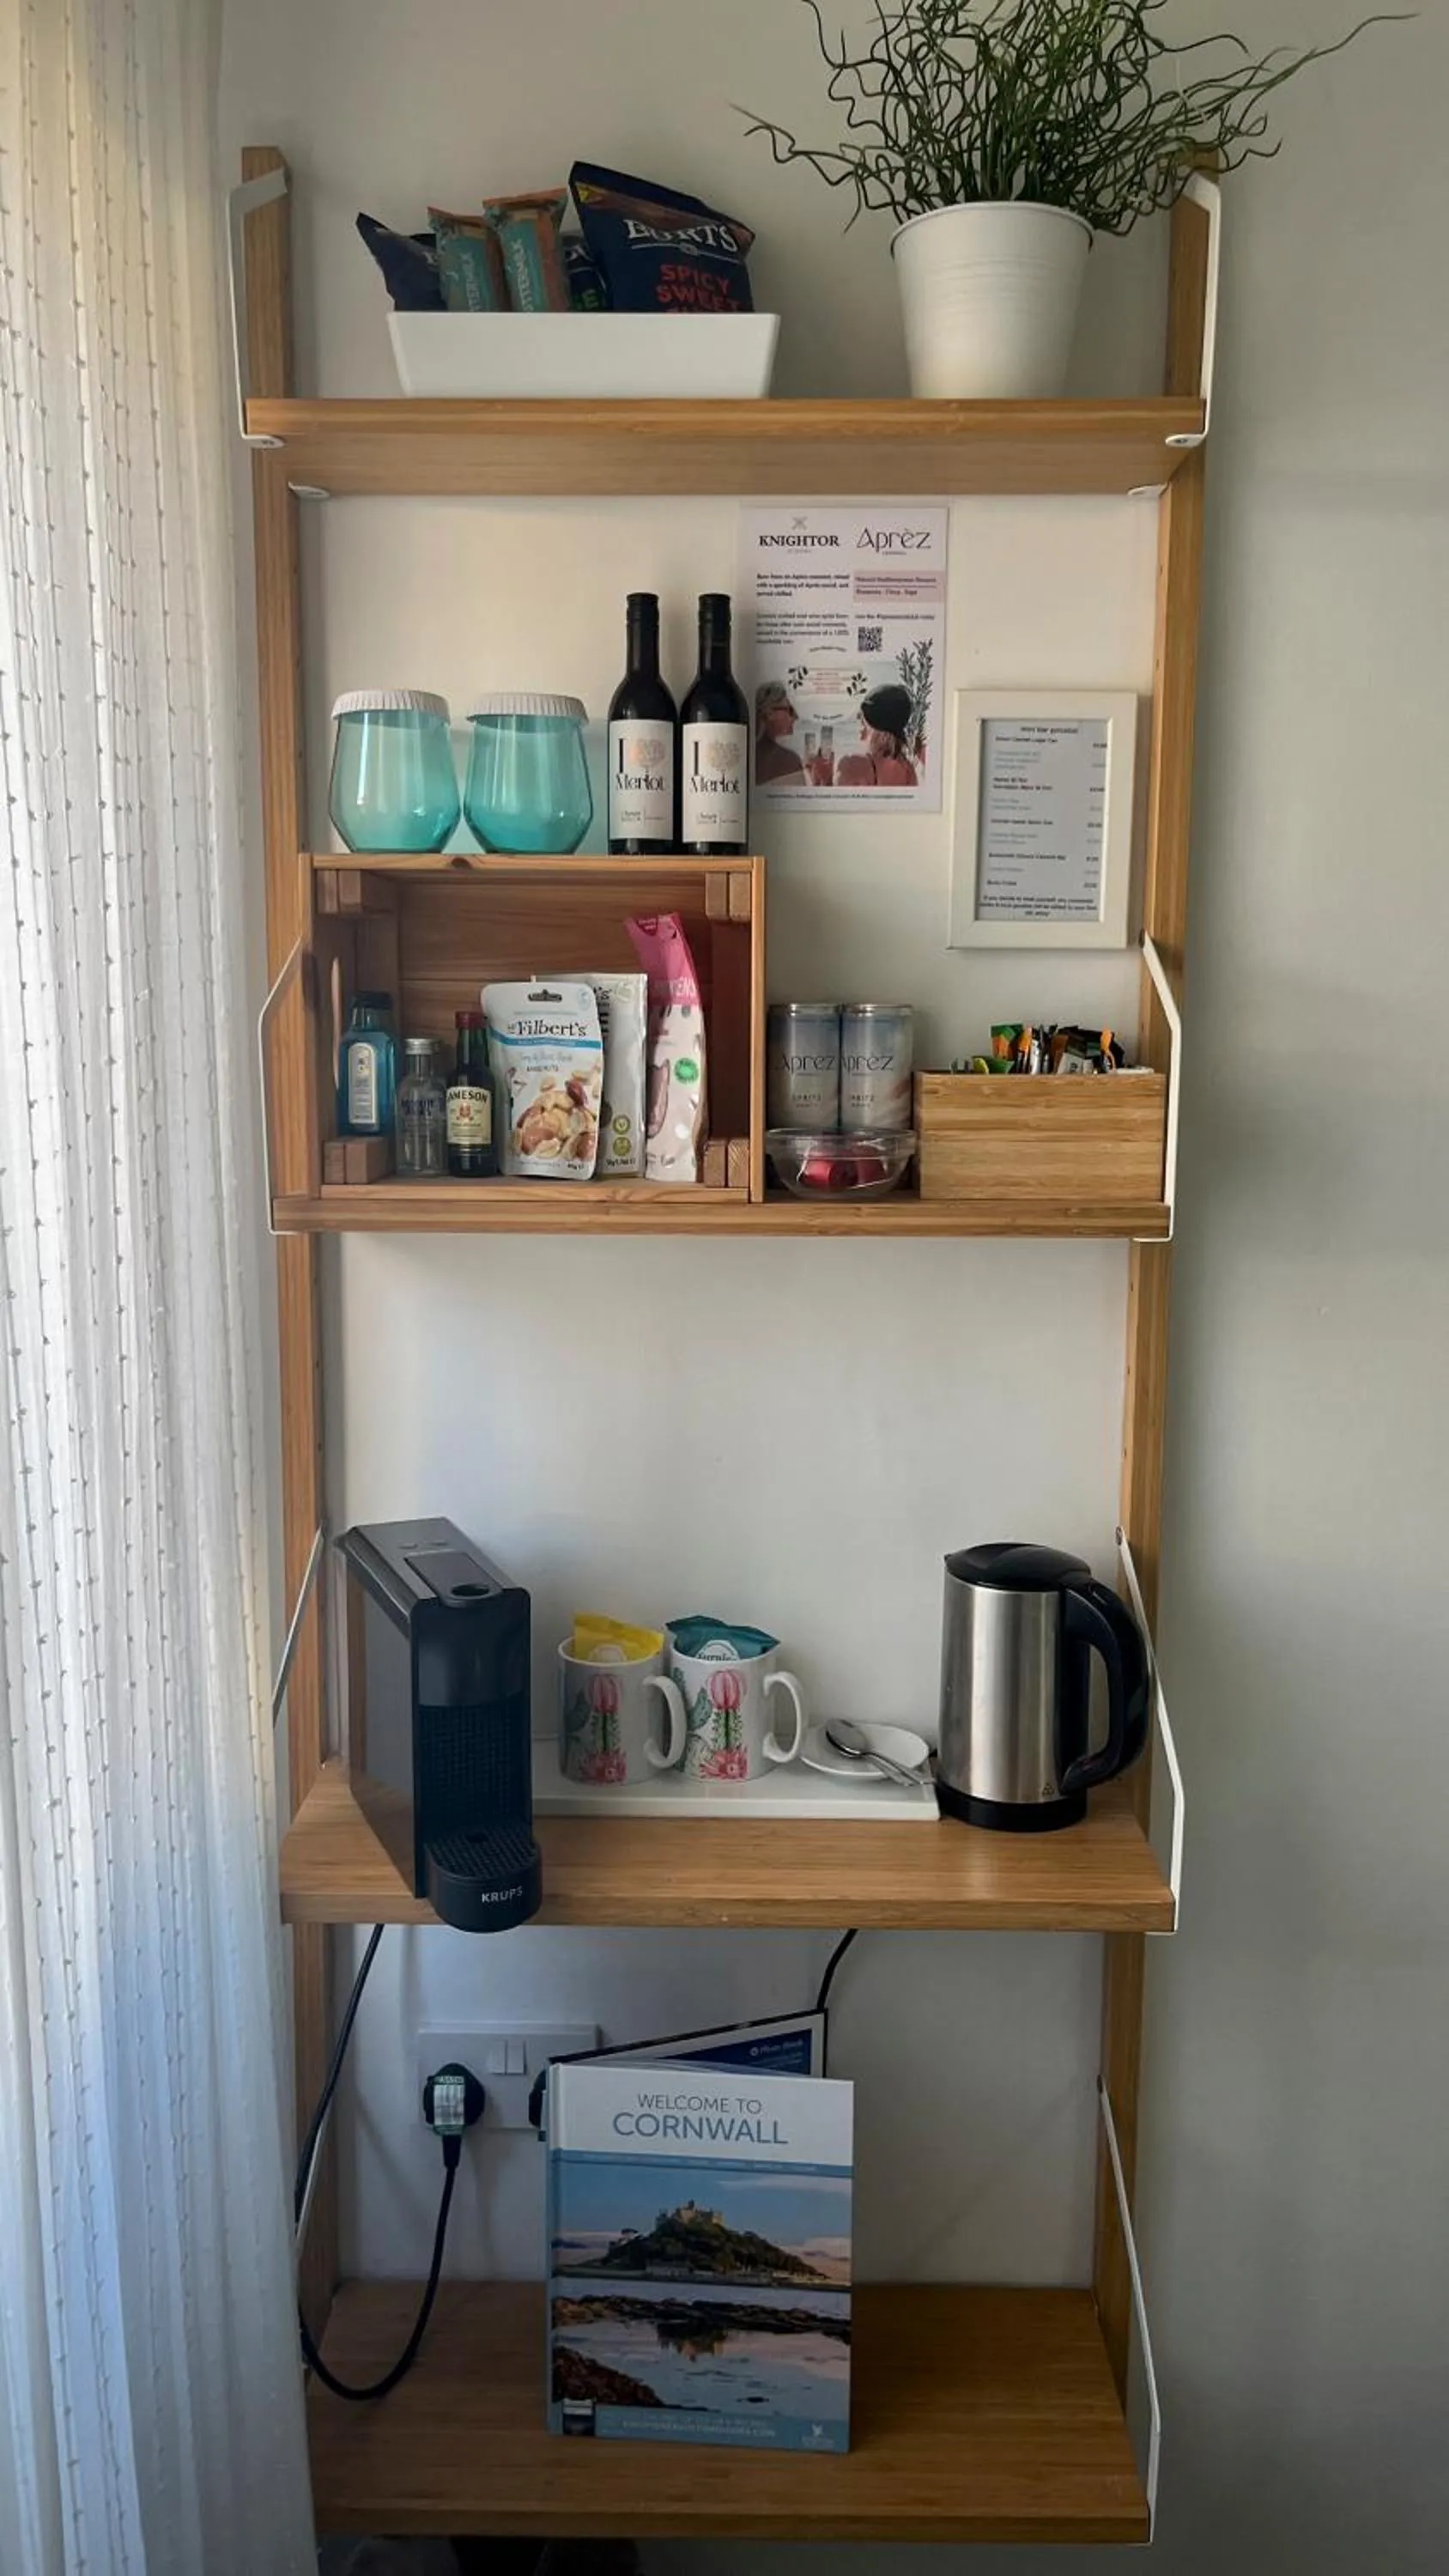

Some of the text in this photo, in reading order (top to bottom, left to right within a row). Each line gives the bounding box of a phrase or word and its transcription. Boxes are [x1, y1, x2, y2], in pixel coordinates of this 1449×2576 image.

[660, 264, 730, 295] SPICY
[656, 284, 743, 312] SWEET
[759, 535, 840, 547] KNIGHTOR
[856, 526, 931, 552] Aprèz
[615, 773, 666, 791] Merlot
[690, 774, 741, 793] Merlot
[518, 1019, 587, 1037] Filbert's
[481, 1886, 523, 1904] KRUPS
[638, 2093, 762, 2115] WELCOME TO
[613, 2111, 789, 2144] CORNWALL
